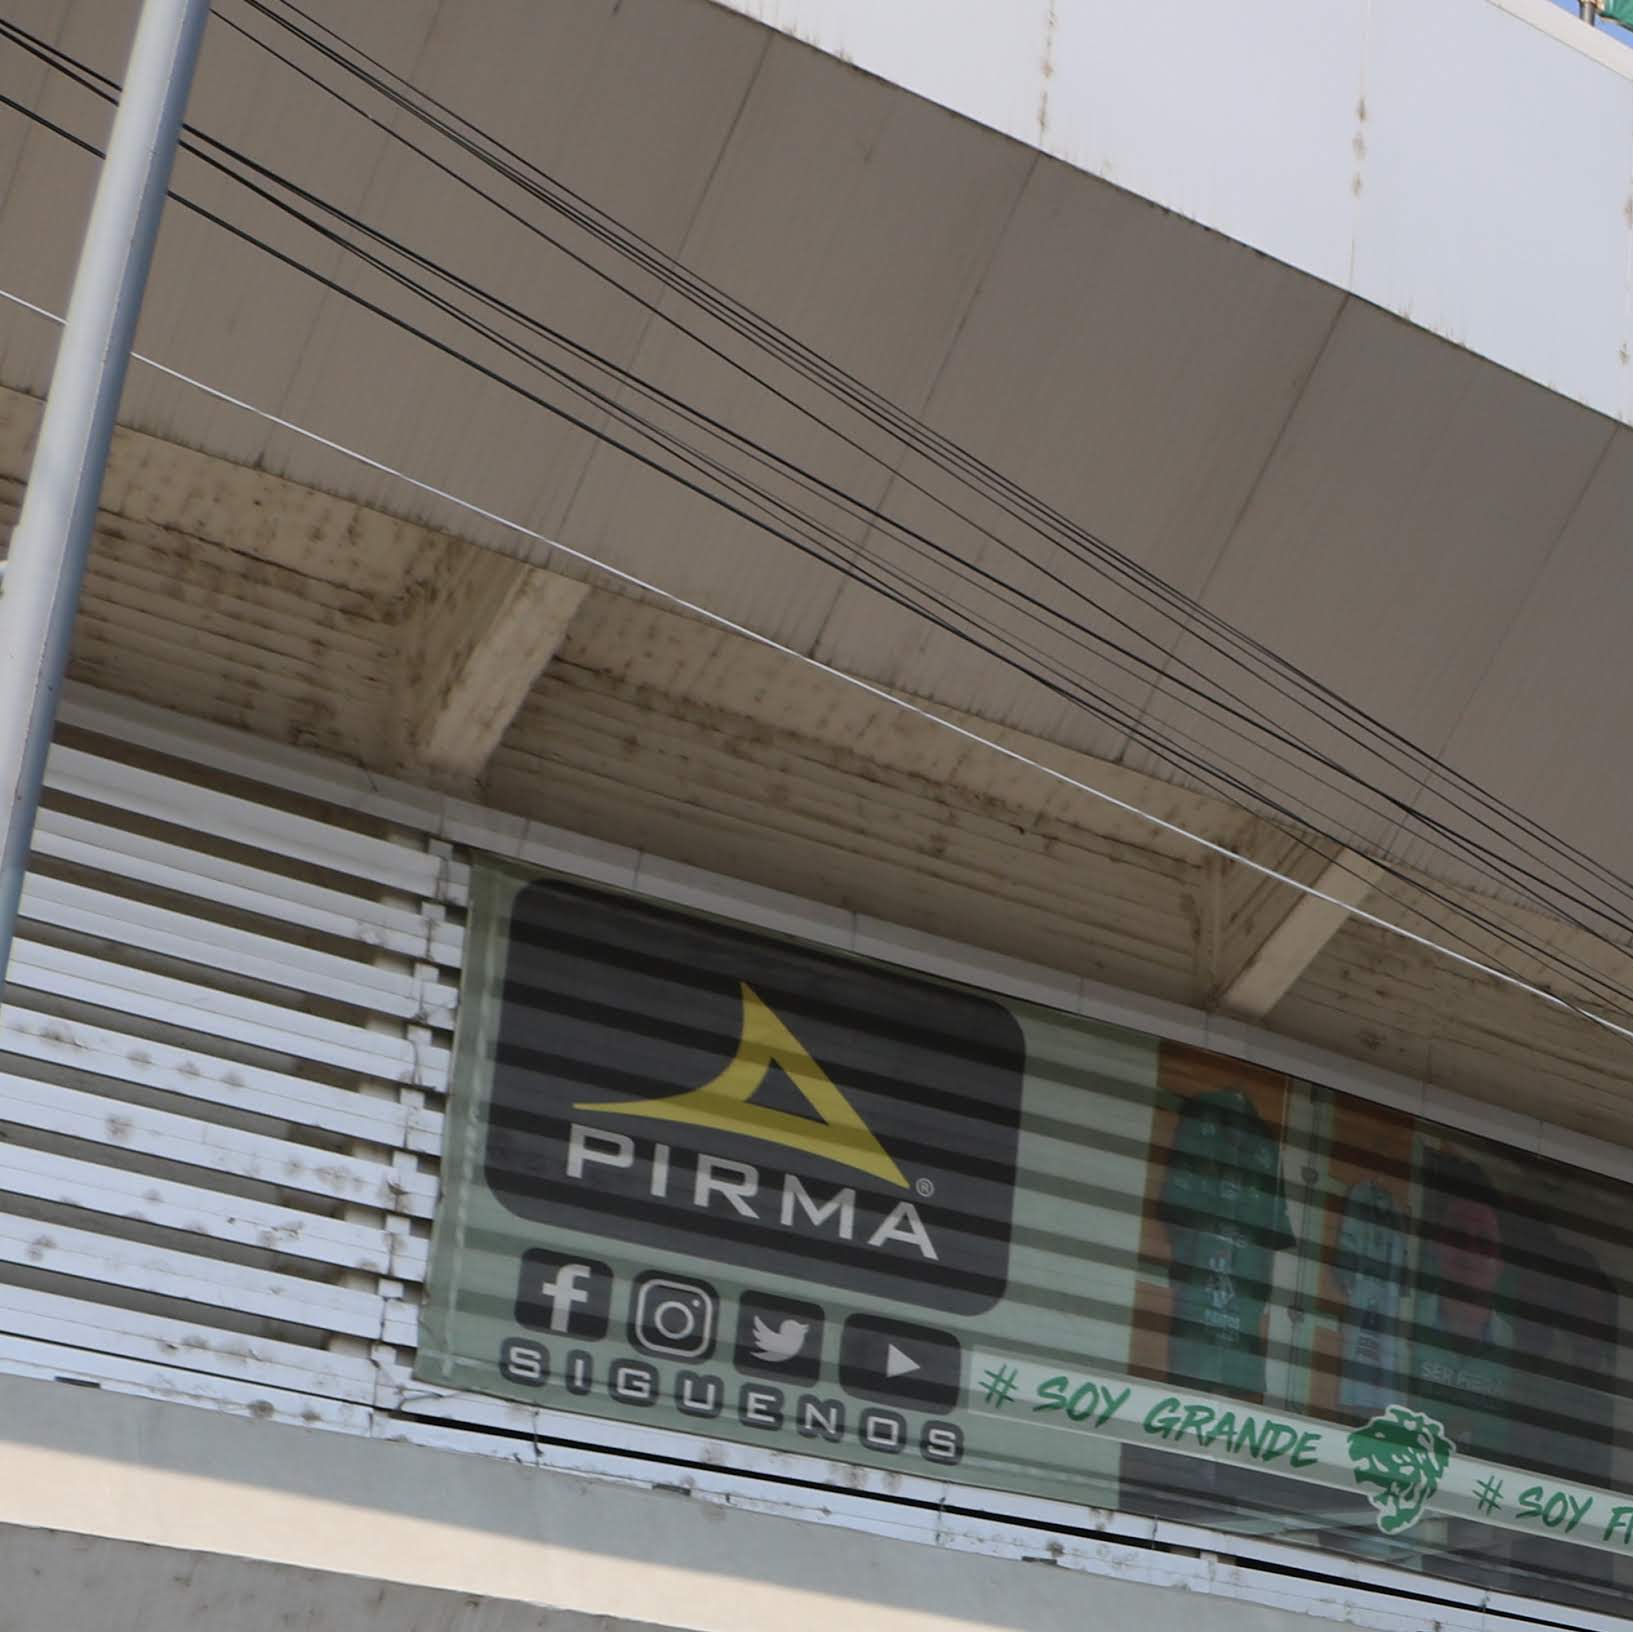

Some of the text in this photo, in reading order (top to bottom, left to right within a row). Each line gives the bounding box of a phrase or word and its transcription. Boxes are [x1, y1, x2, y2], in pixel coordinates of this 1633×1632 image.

[565, 1123, 939, 1261] PIRMA
[506, 1345, 958, 1460] SIGUENOS
[1034, 1375, 1131, 1427] SOY
[1144, 1399, 1322, 1468] GRANDE
[1518, 1486, 1594, 1532] SOY
